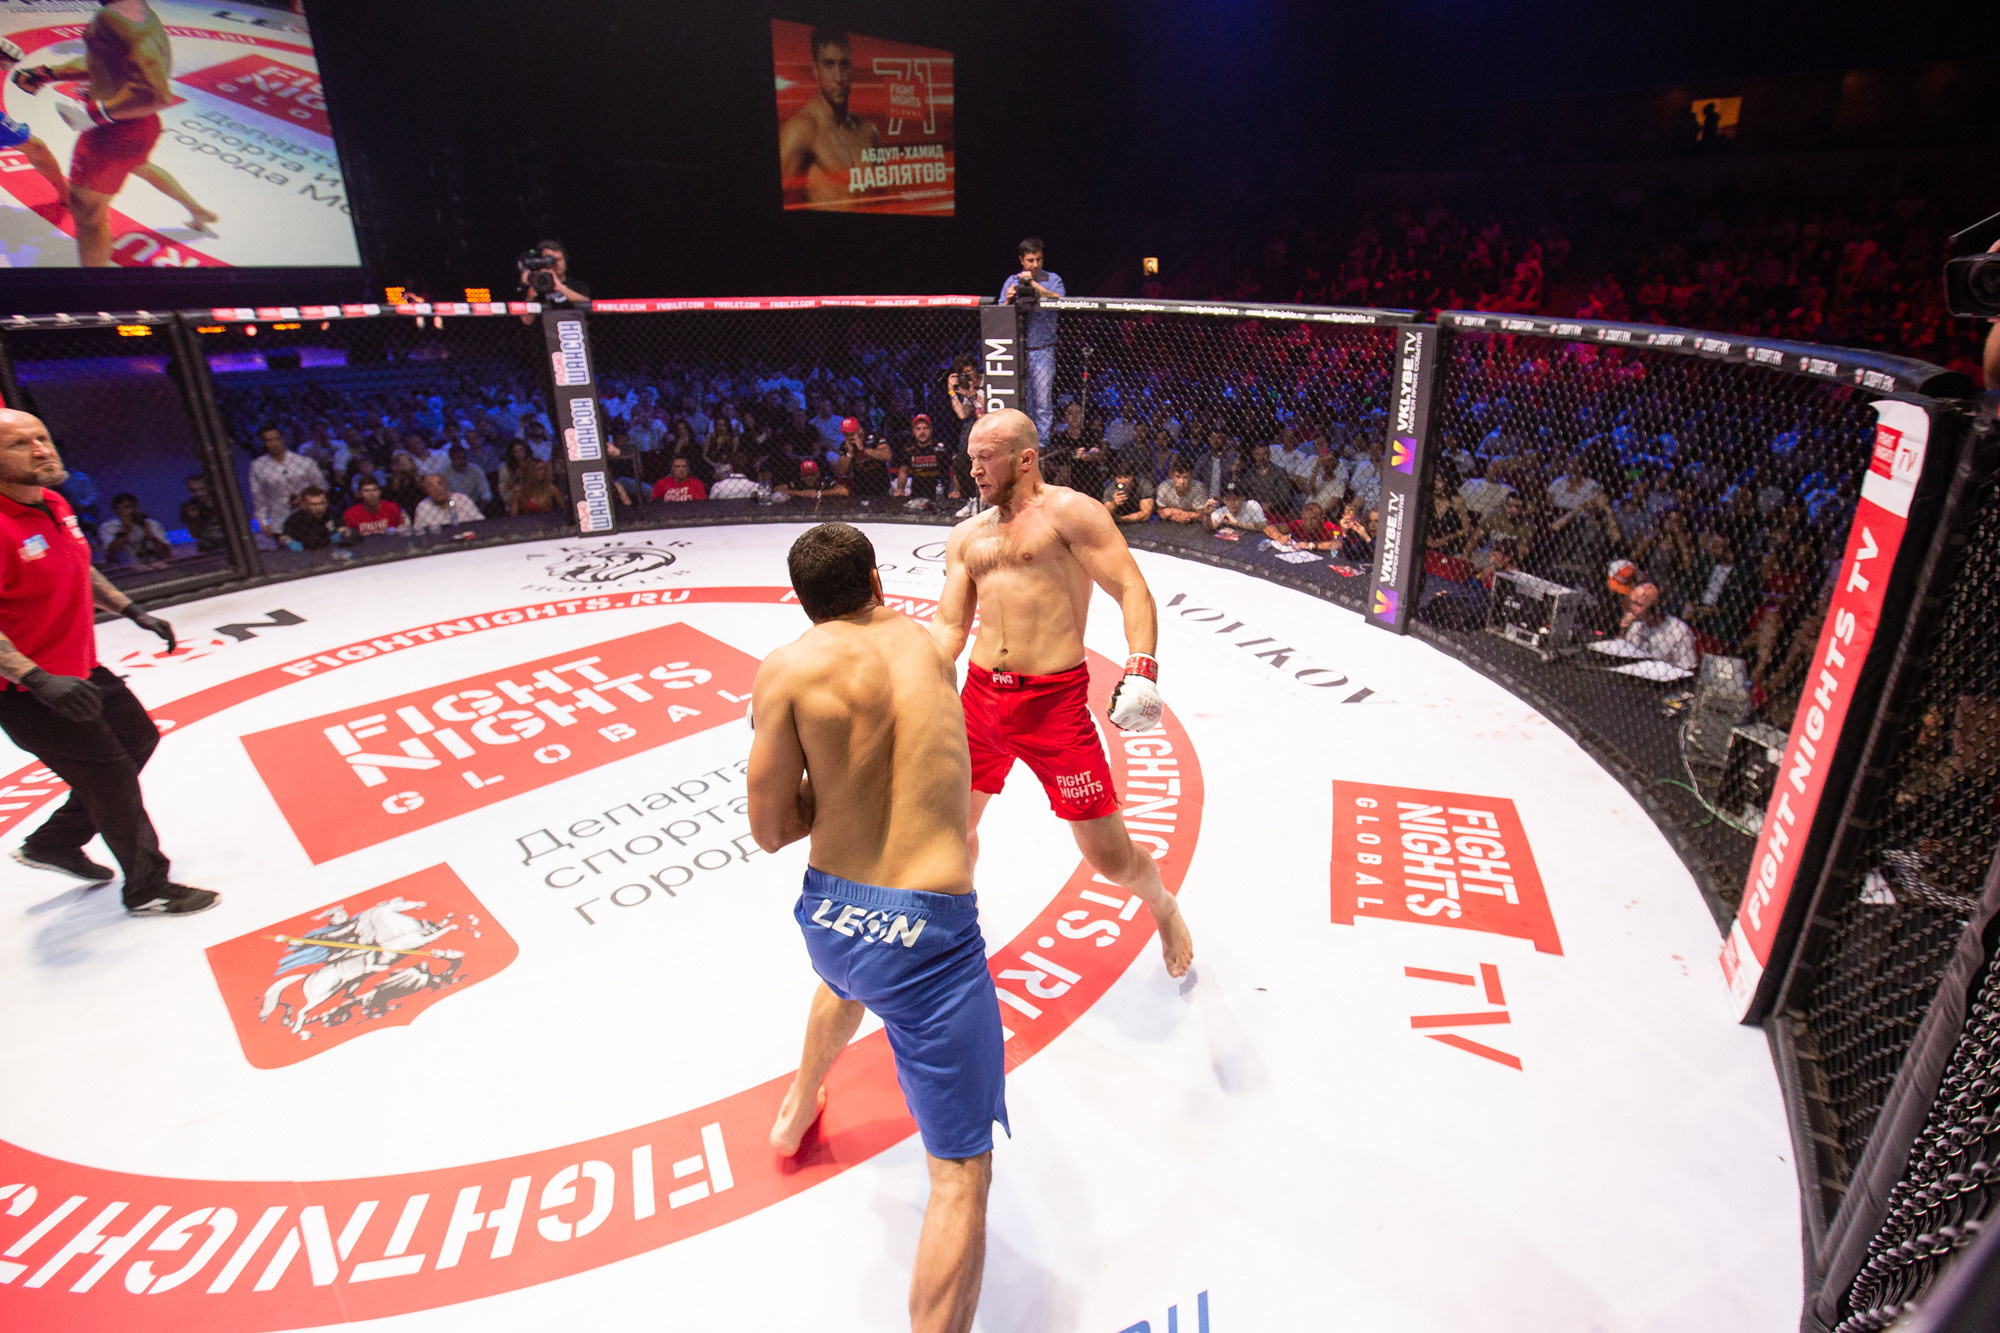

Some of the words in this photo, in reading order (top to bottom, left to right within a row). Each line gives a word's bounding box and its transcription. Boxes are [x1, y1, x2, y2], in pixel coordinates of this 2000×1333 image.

[848, 162, 947, 193] ДАВЛЯТОВ
[860, 144, 945, 164] АБДУЛ-ХАМИД
[559, 321, 589, 384] ШАНСОН
[985, 339, 1014, 376] FM
[1397, 331, 1417, 432] VKLYBE.TV
[571, 398, 600, 459] ШАНСОН
[584, 472, 611, 530] ШАНСОН
[1380, 491, 1400, 582] VKLYBE.TV
[280, 589, 691, 678] FIGHTNIGHTS.RU
[323, 655, 602, 757] FIGHT
[992, 673, 1014, 684] FNG
[345, 660, 713, 788] NIGHTS
[382, 686, 752, 814] GLOBAL
[1746, 792, 1796, 932] FIGHT
[1788, 607, 1856, 795] NIGHTS
[1846, 526, 1879, 592] TV
[1056, 770, 1092, 788] FIGHT
[1060, 780, 1103, 800] NIGHTS
[1355, 797, 1384, 909] GLOBAL
[1397, 801, 1462, 919] NIGHTS
[1447, 807, 1520, 905] FIGHT
[811, 899, 927, 948] LEON
[1404, 962, 1523, 1071] TV
